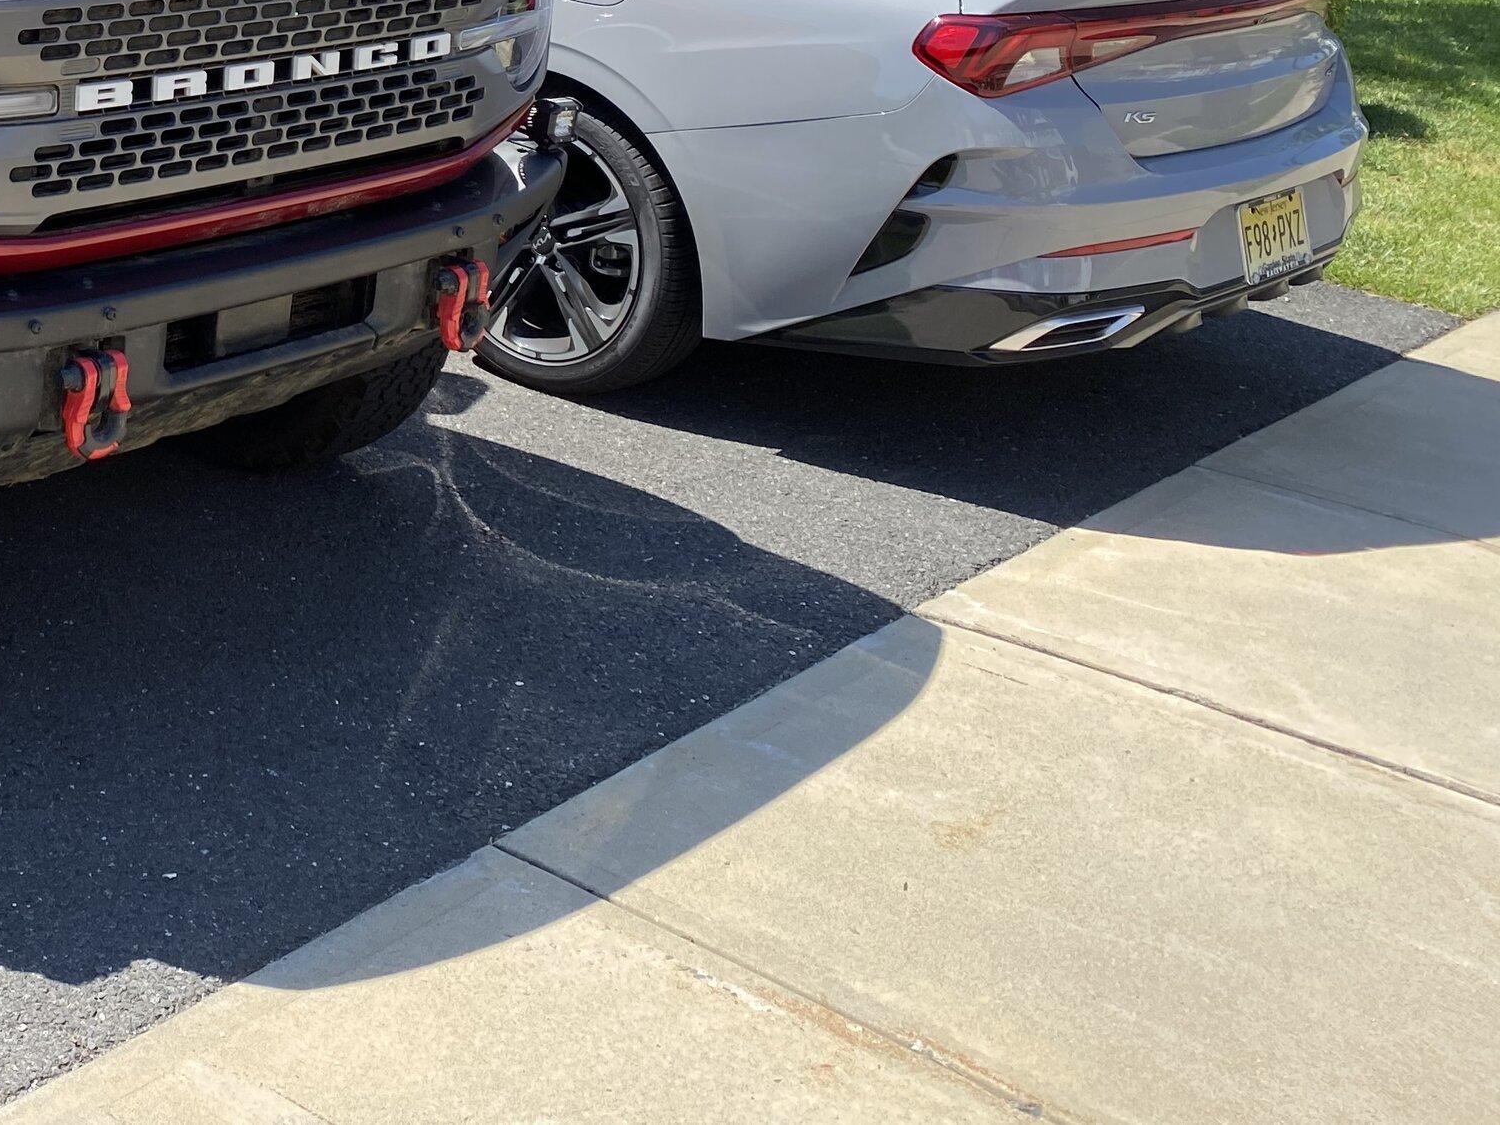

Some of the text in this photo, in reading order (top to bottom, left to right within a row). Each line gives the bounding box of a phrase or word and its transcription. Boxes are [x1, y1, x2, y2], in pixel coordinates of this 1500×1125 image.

[75, 32, 451, 112] BRONCO
[1124, 112, 1156, 124] K5
[1245, 208, 1305, 263] F98 PXZ
